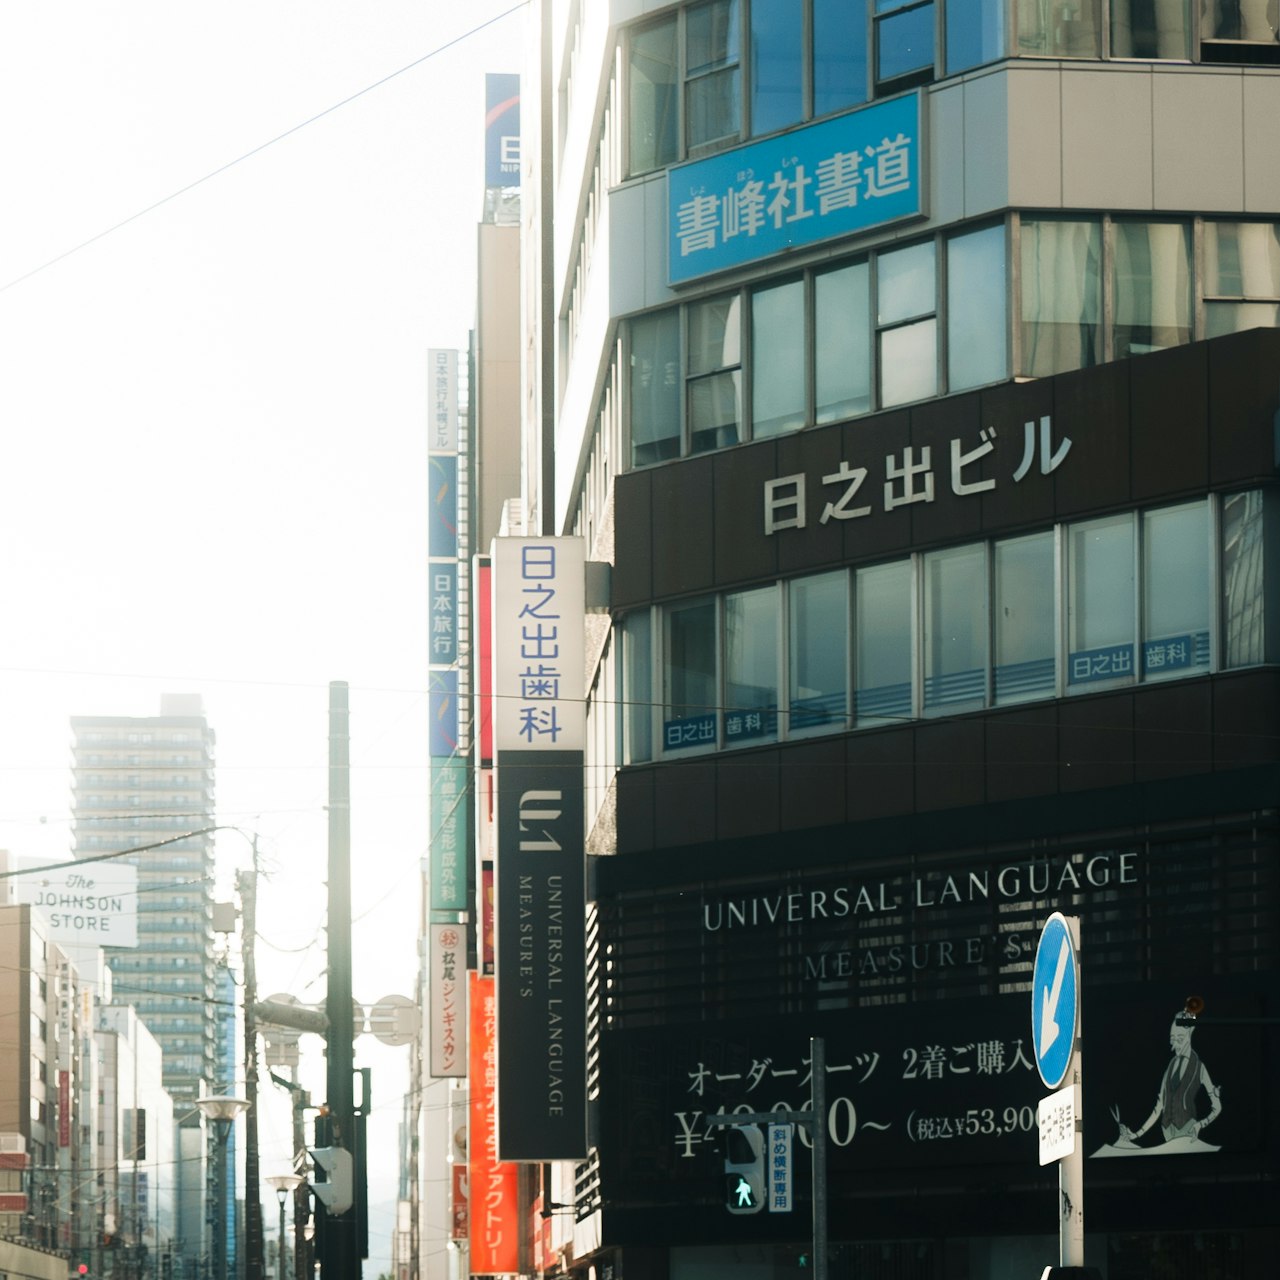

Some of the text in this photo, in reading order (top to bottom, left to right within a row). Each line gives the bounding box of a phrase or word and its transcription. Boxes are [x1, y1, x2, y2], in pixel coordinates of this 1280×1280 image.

[676, 134, 912, 257] 書峰社書道
[436, 353, 449, 448] 日本旅行札幌ビル
[764, 416, 1073, 536] 日之出ビル
[433, 575, 452, 653] 日本旅行
[518, 546, 562, 743] 日之出歯科
[1074, 642, 1187, 678] 日之出 歯科
[668, 712, 763, 745] 日之出 歯科
[34, 892, 123, 912] JOHNSON
[65, 874, 95, 889] The
[703, 852, 1140, 932] UNIVERSAL LANGUAGE
[50, 913, 110, 932] STORE
[519, 875, 533, 998] MEASURE'S
[805, 933, 1027, 981] MEASURE'S
[441, 951, 457, 1072] 松尾ジンギスカン
[548, 875, 564, 1117] UNIVERSAL LANGUAGE
[773, 1129, 787, 1209] 斜め横断専用
